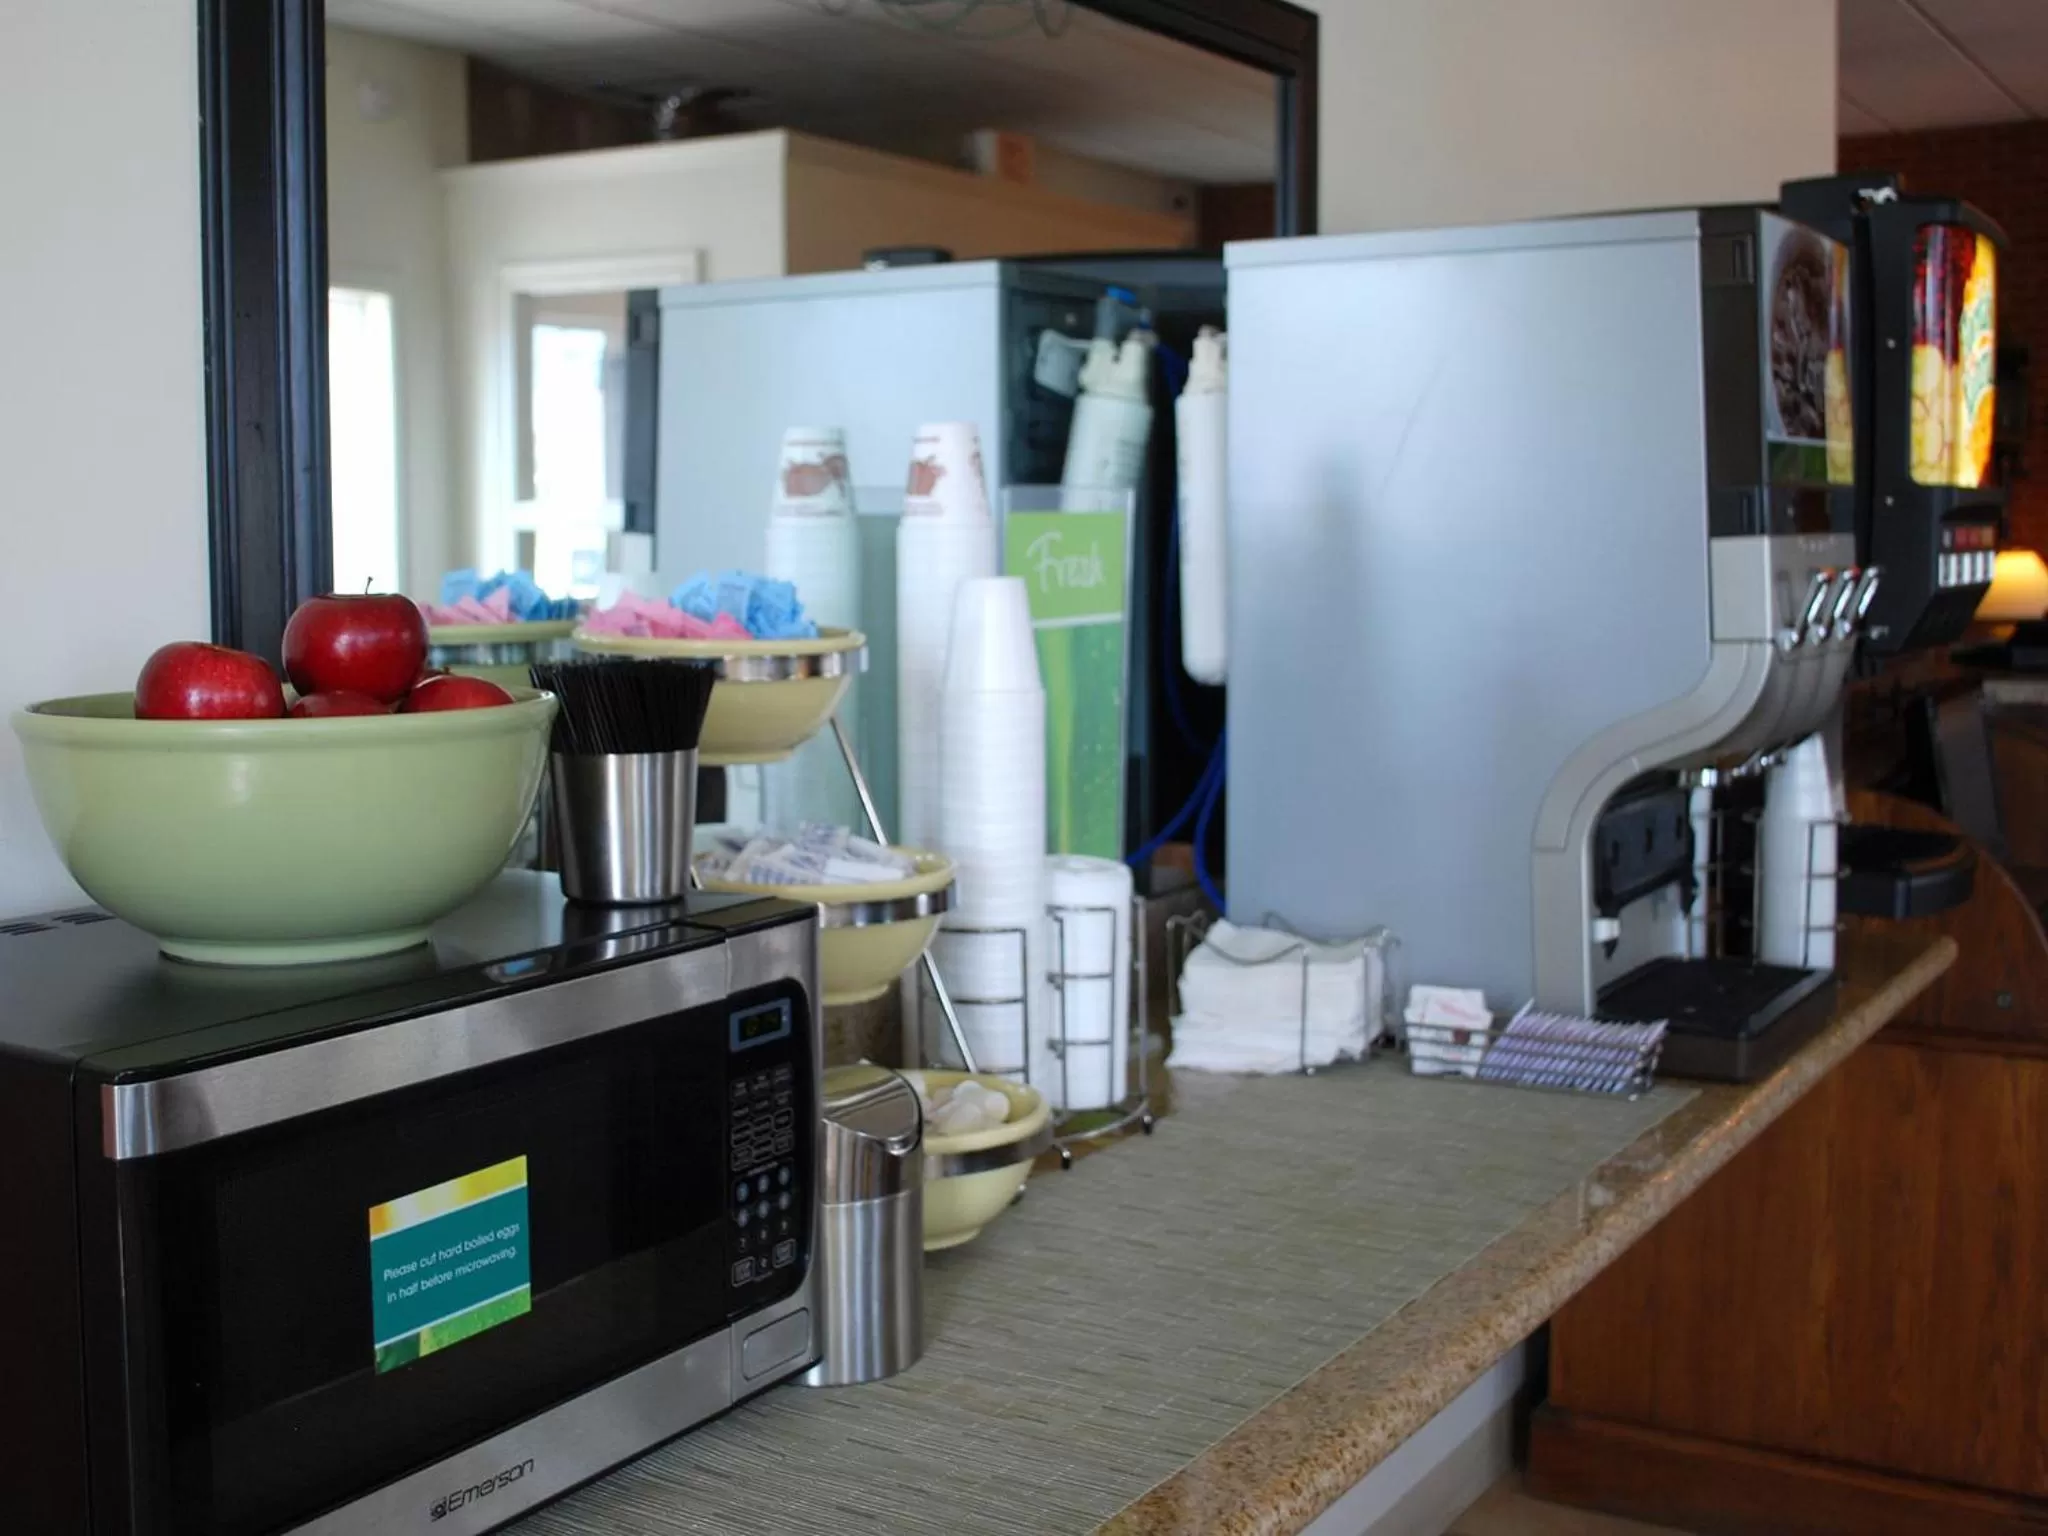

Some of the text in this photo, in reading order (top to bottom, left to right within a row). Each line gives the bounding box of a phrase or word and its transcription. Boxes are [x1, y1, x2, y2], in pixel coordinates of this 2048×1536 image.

[384, 1223, 520, 1282] Please cut hard boiled eggs
[387, 1292, 397, 1304] in
[399, 1282, 419, 1298] half
[421, 1270, 453, 1291] before
